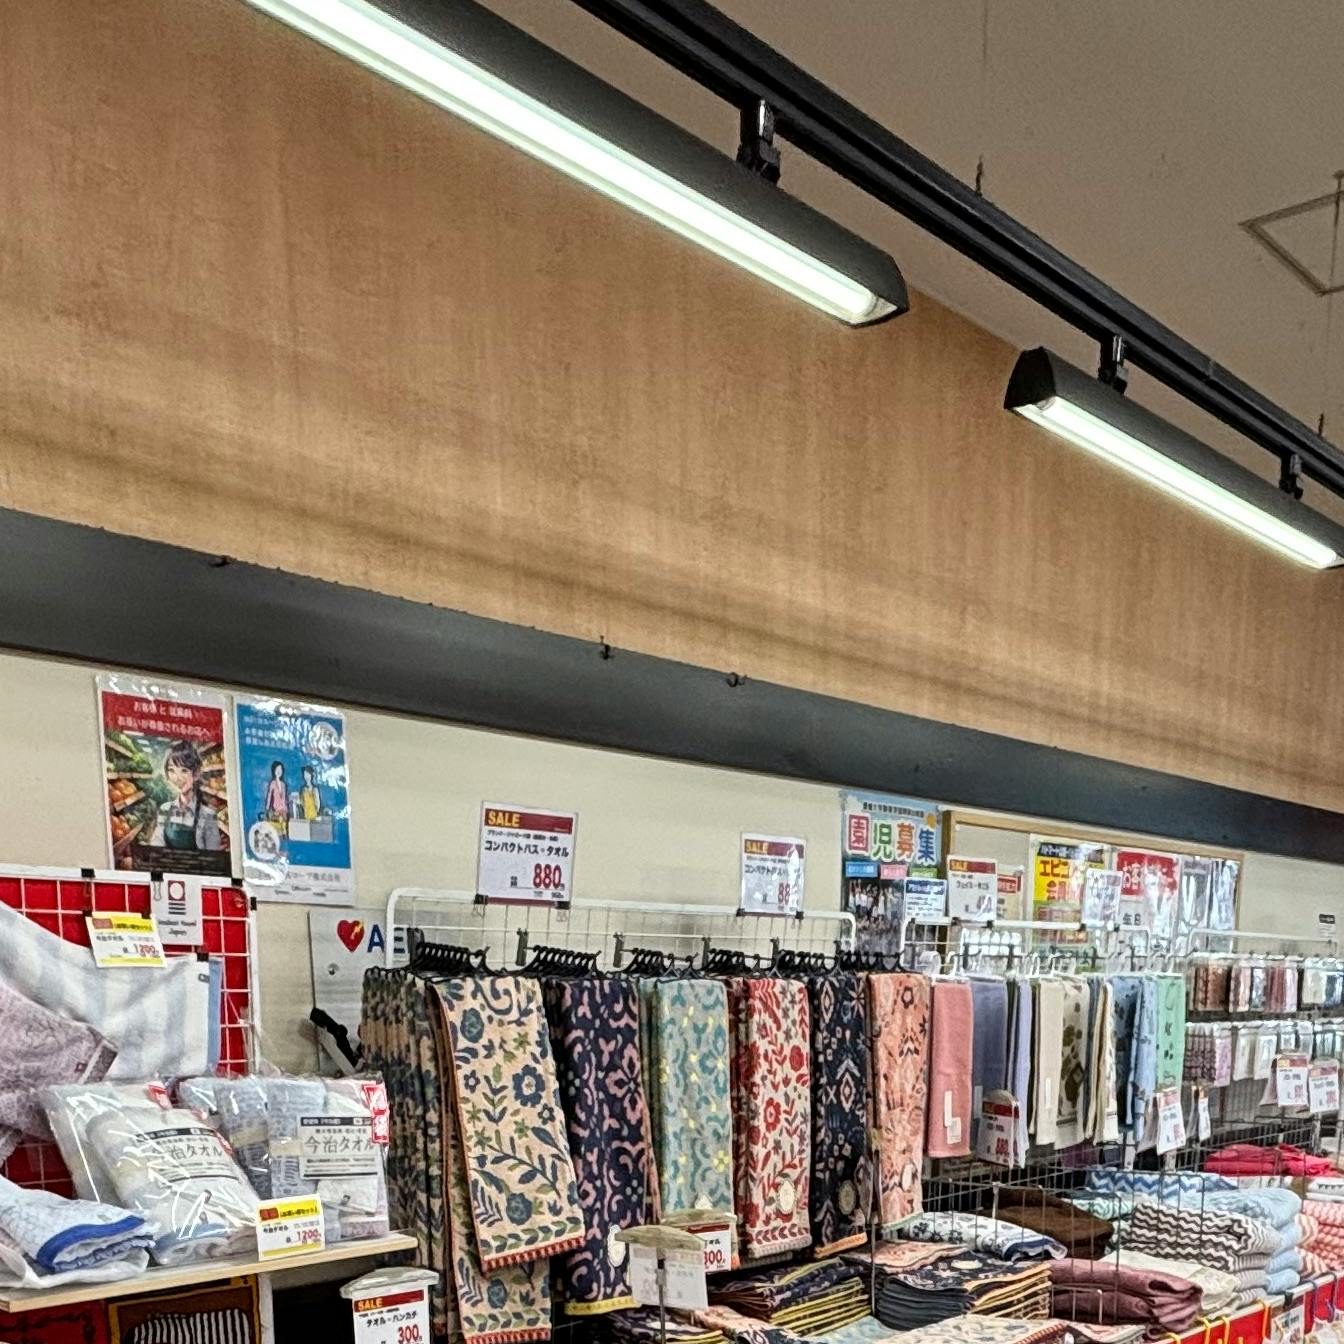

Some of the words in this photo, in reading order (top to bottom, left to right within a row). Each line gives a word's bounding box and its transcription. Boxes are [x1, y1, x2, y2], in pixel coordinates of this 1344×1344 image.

[488, 811, 521, 828] SALE
[847, 813, 935, 863] 園児募集
[367, 924, 409, 954] AE
[357, 1297, 383, 1312] SALE
